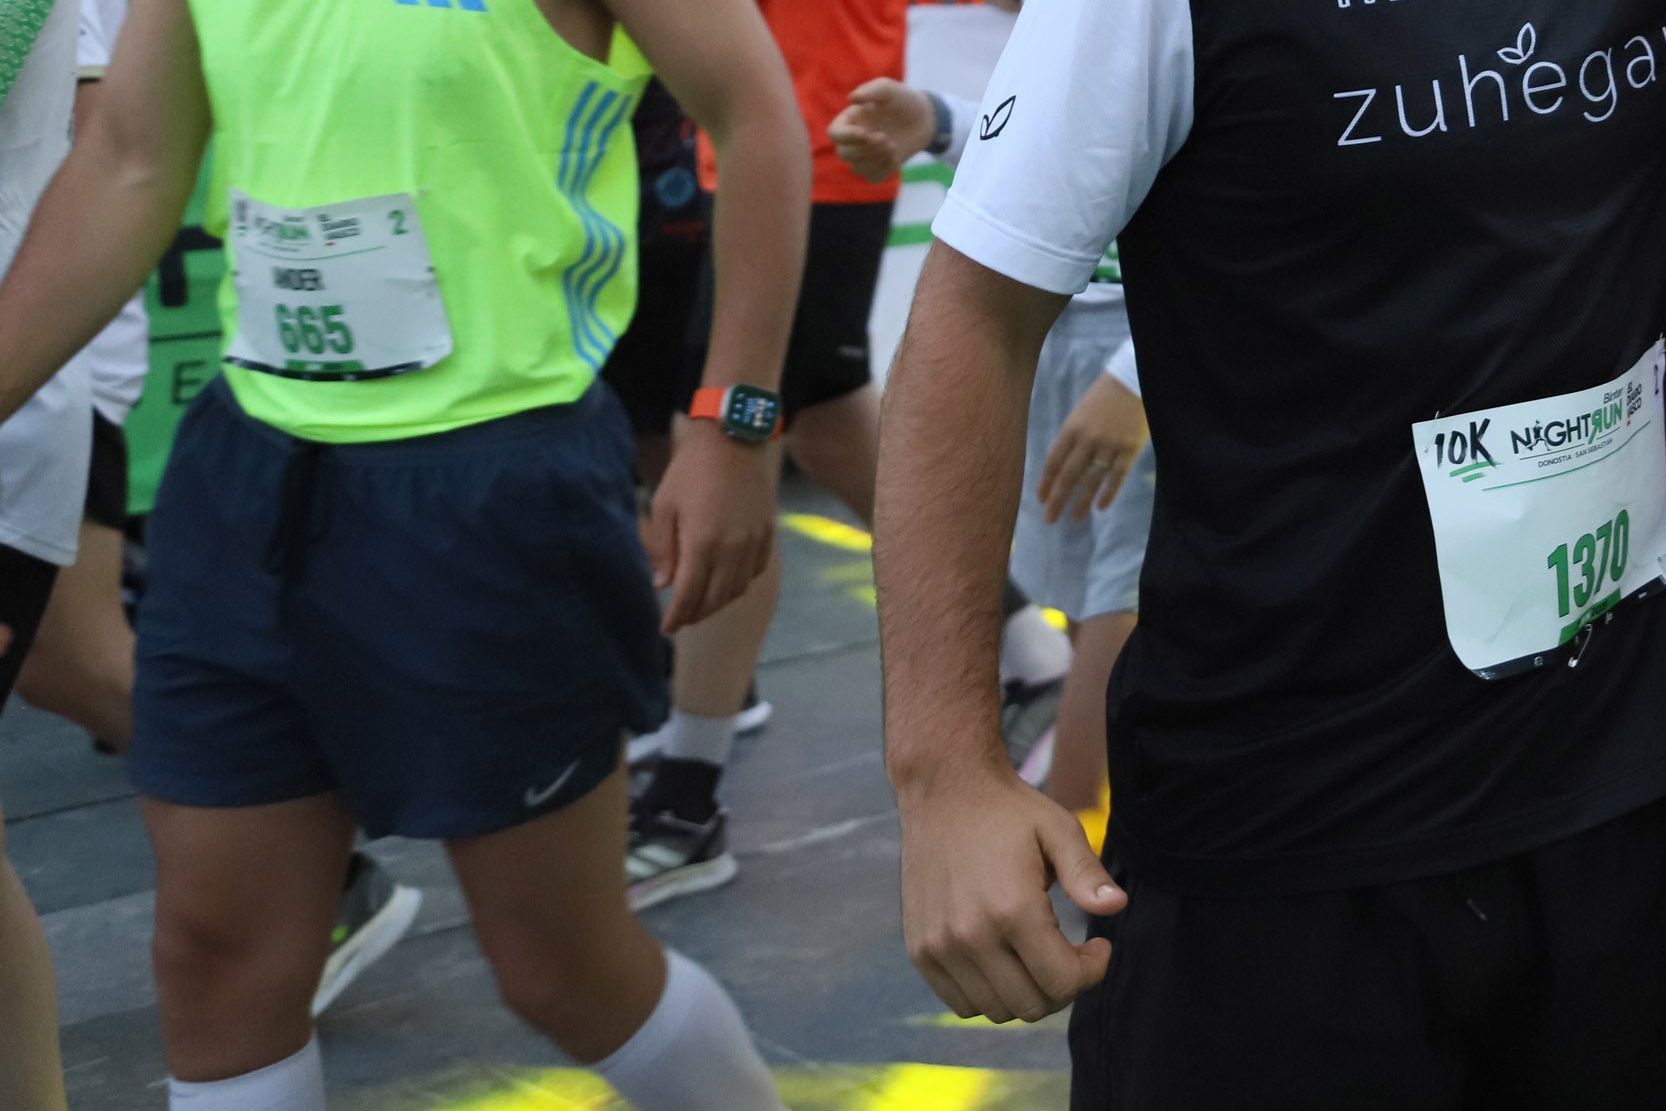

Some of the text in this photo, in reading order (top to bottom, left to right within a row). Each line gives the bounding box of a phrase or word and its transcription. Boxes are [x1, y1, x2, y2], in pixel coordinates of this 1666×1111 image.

[387, 209, 409, 235] 2
[275, 303, 354, 354] 665
[1434, 418, 1497, 469] 10K
[1538, 455, 1572, 468] DONOSTIA
[1575, 450, 1588, 458] SAN
[1547, 509, 1630, 618] 1370
